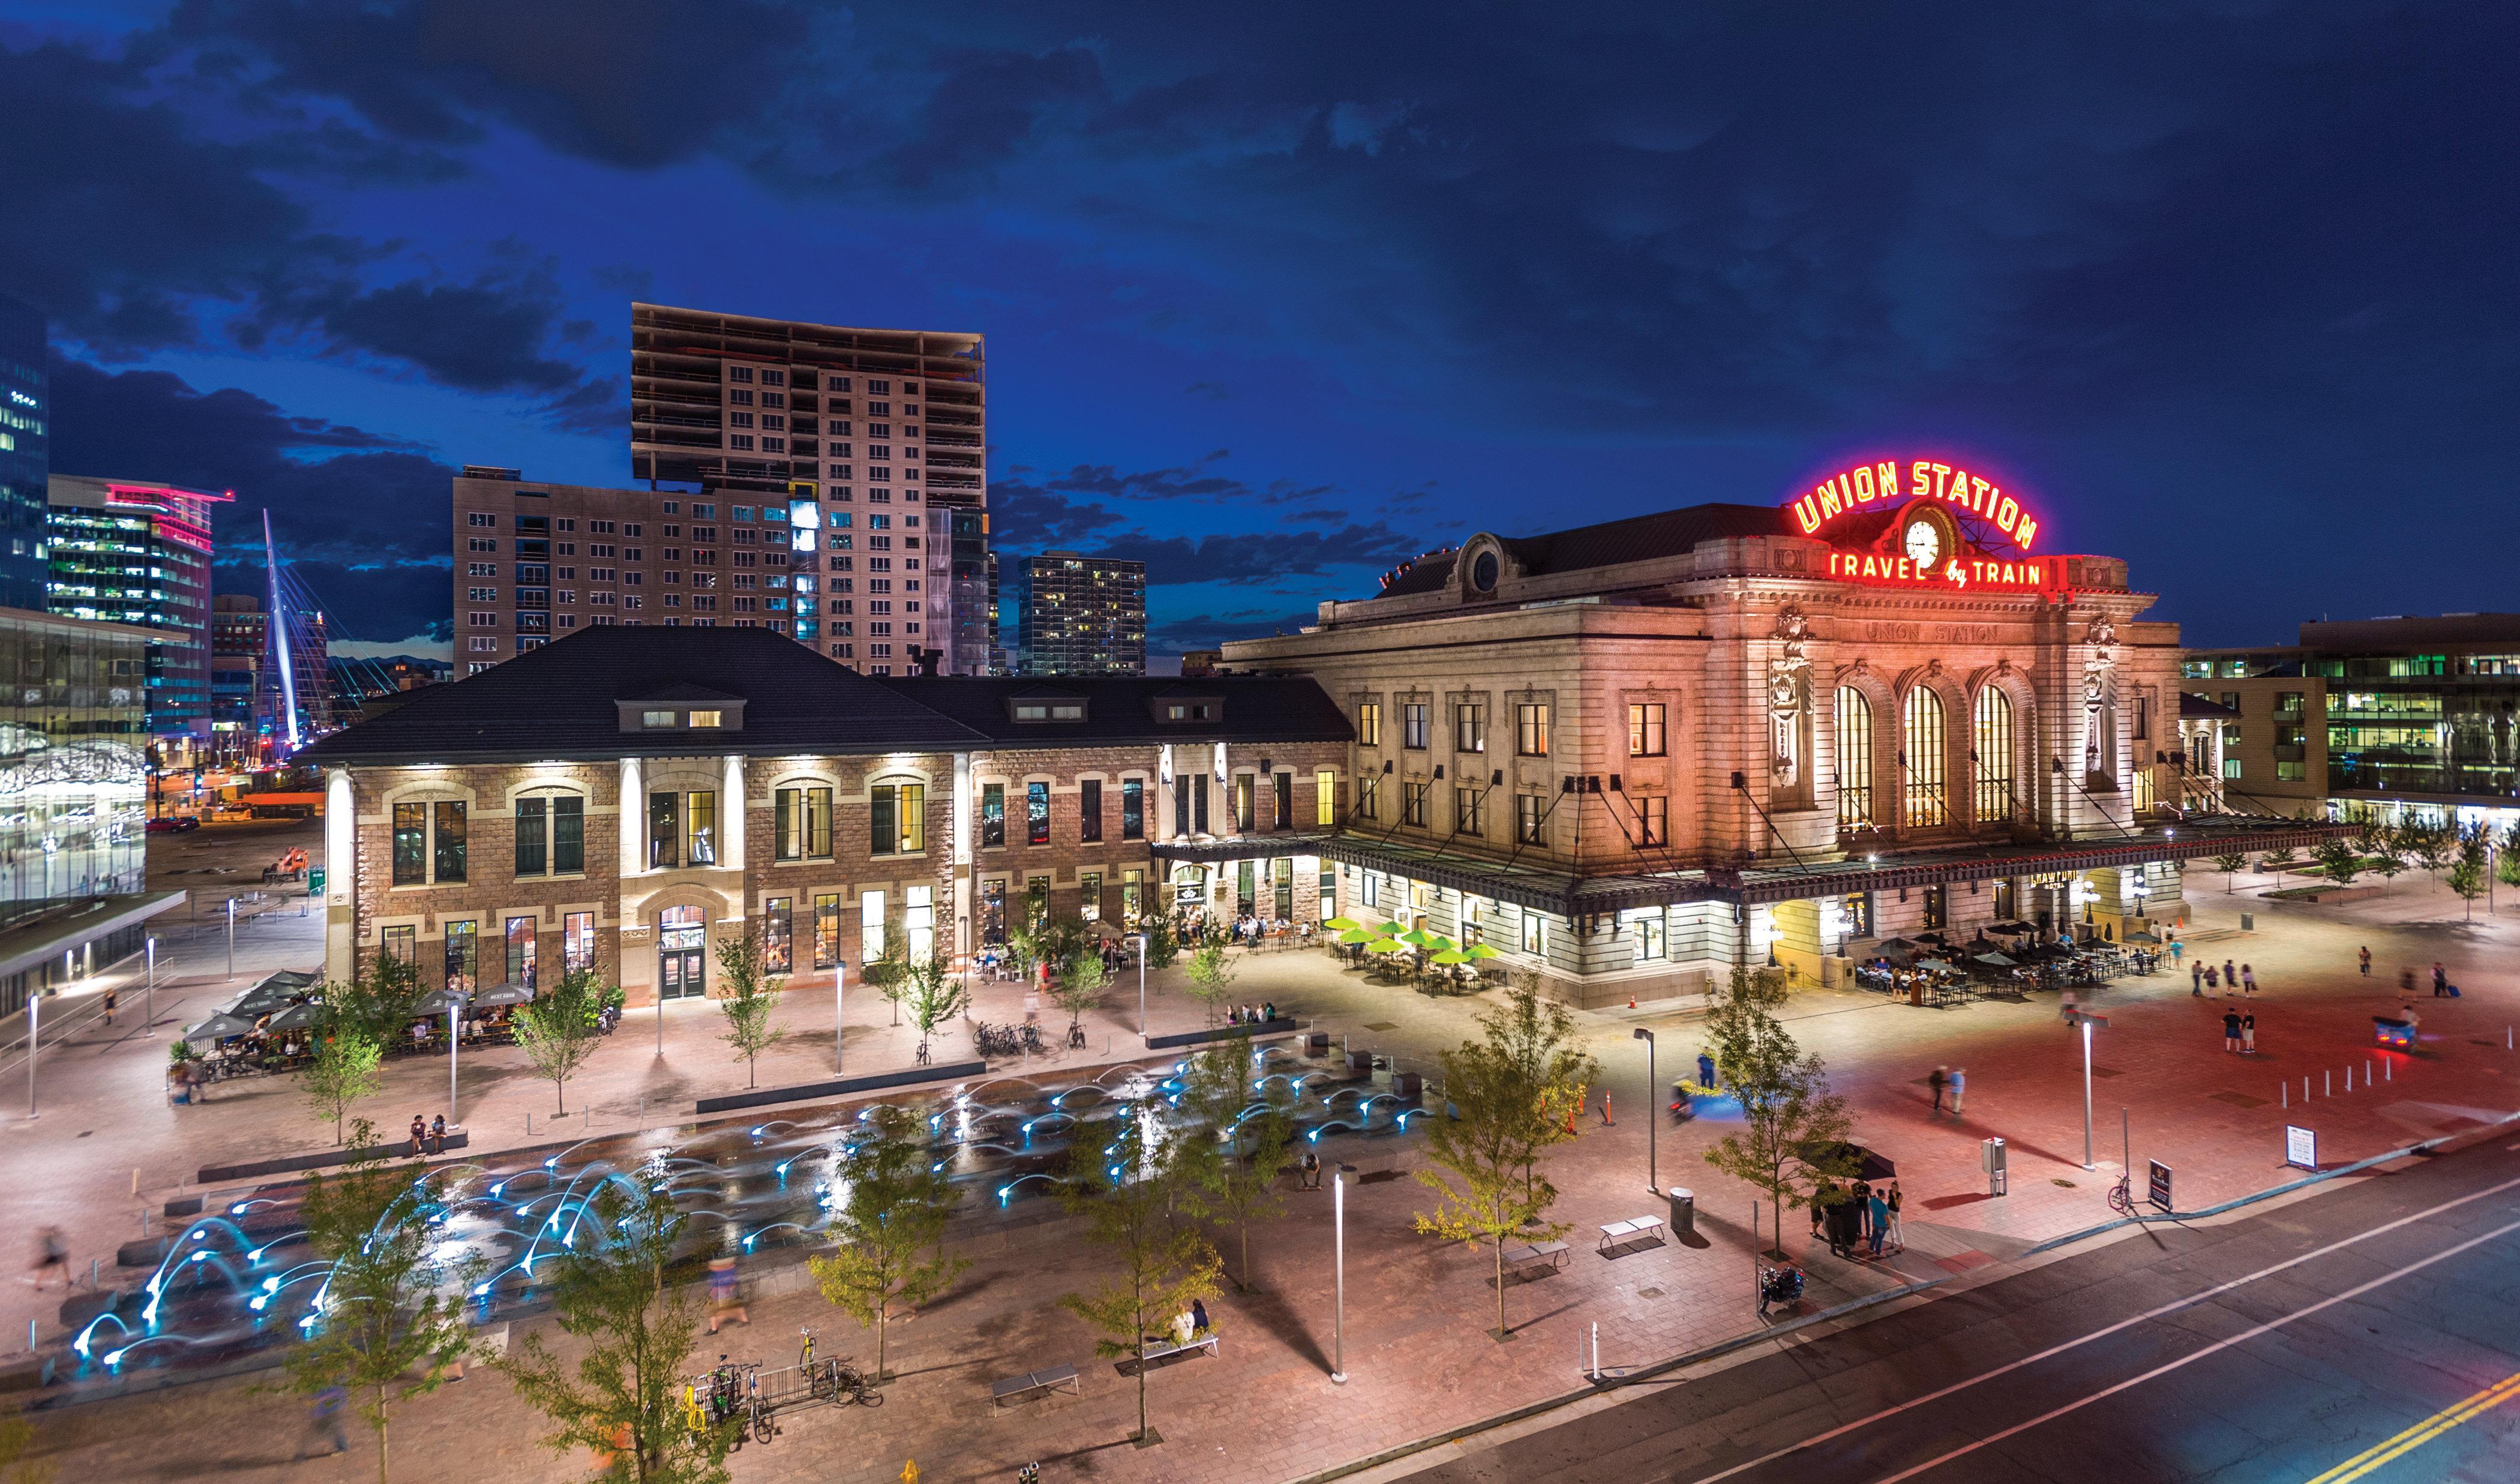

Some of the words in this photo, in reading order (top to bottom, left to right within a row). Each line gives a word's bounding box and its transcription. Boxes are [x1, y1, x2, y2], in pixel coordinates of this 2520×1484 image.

[1795, 461, 1898, 533] UNION
[1912, 461, 2037, 550] STATION
[1831, 554, 1927, 580] TRAVEL
[1946, 559, 1967, 588] by
[1973, 562, 2039, 584] TRAIN
[1866, 622, 1920, 640] UNION
[1936, 625, 1997, 642] STATION
